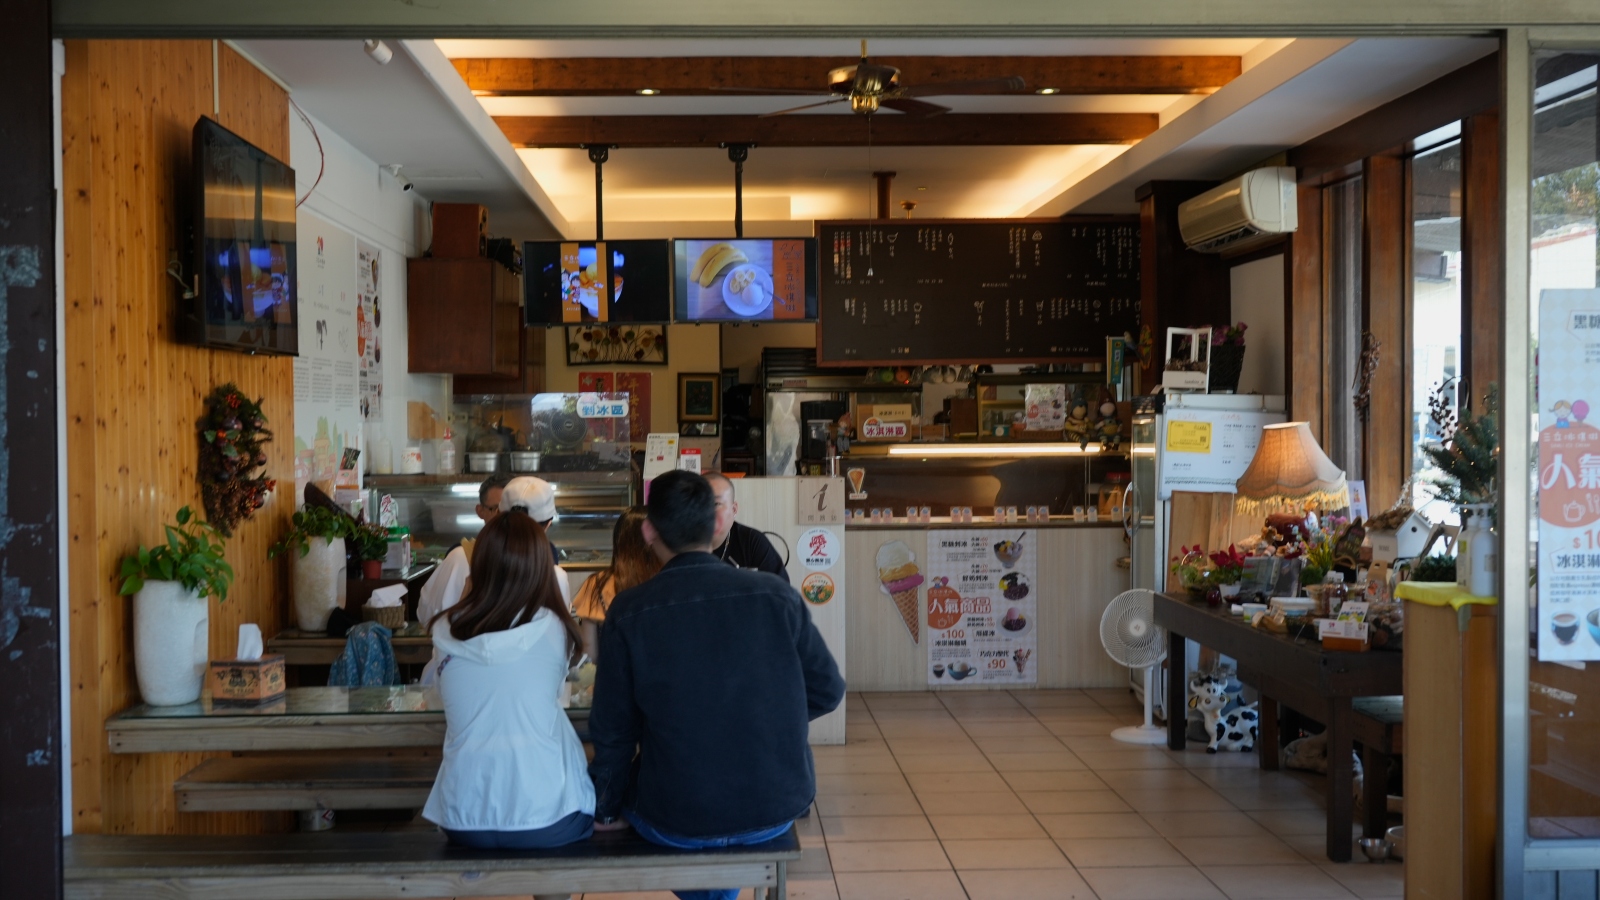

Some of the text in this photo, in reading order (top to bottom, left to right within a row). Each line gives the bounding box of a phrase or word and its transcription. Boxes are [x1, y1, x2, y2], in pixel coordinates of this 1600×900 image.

[866, 426, 904, 437] 冰淇淋區
[929, 597, 992, 615] 人氣商品
[941, 629, 964, 639] $100
[988, 659, 1005, 669] $90
